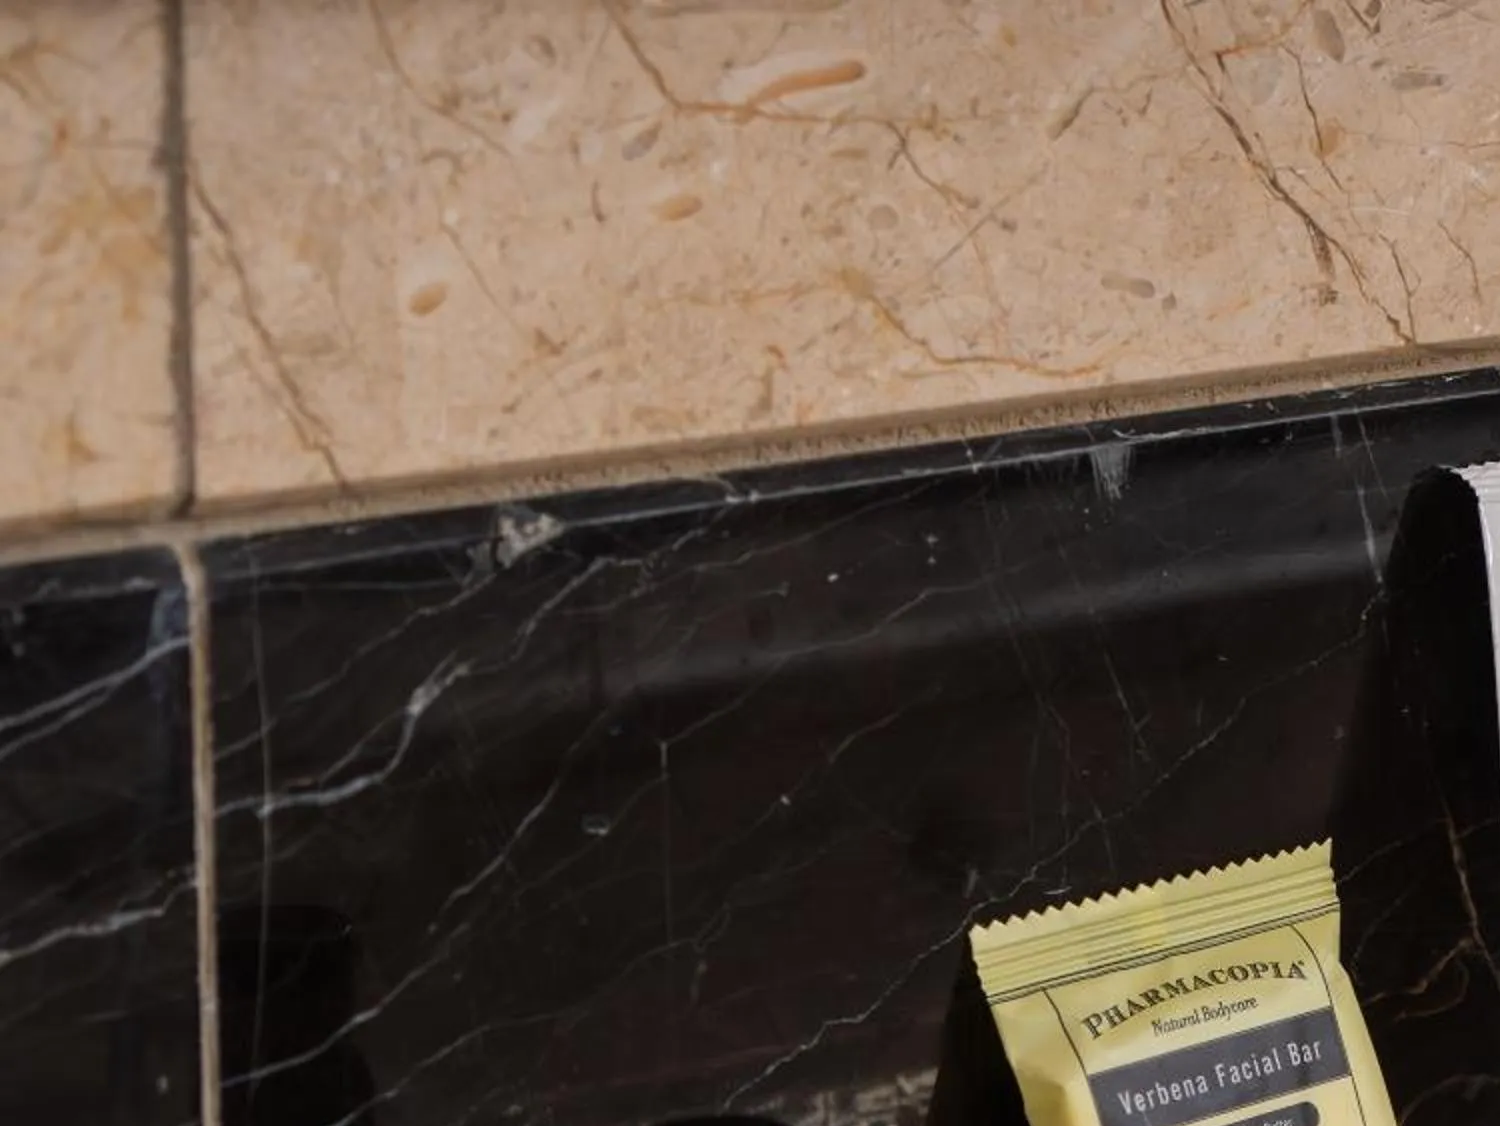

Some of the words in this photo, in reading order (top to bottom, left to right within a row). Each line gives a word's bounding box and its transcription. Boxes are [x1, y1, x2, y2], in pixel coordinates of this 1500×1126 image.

[1082, 960, 1308, 1040] PHARMACOPIA
[1153, 1013, 1201, 1036] Natural
[1201, 996, 1259, 1022] Bodycare
[1117, 1074, 1208, 1115] Verbena
[1215, 1049, 1282, 1087] Facial
[1287, 1040, 1322, 1066] Bar
